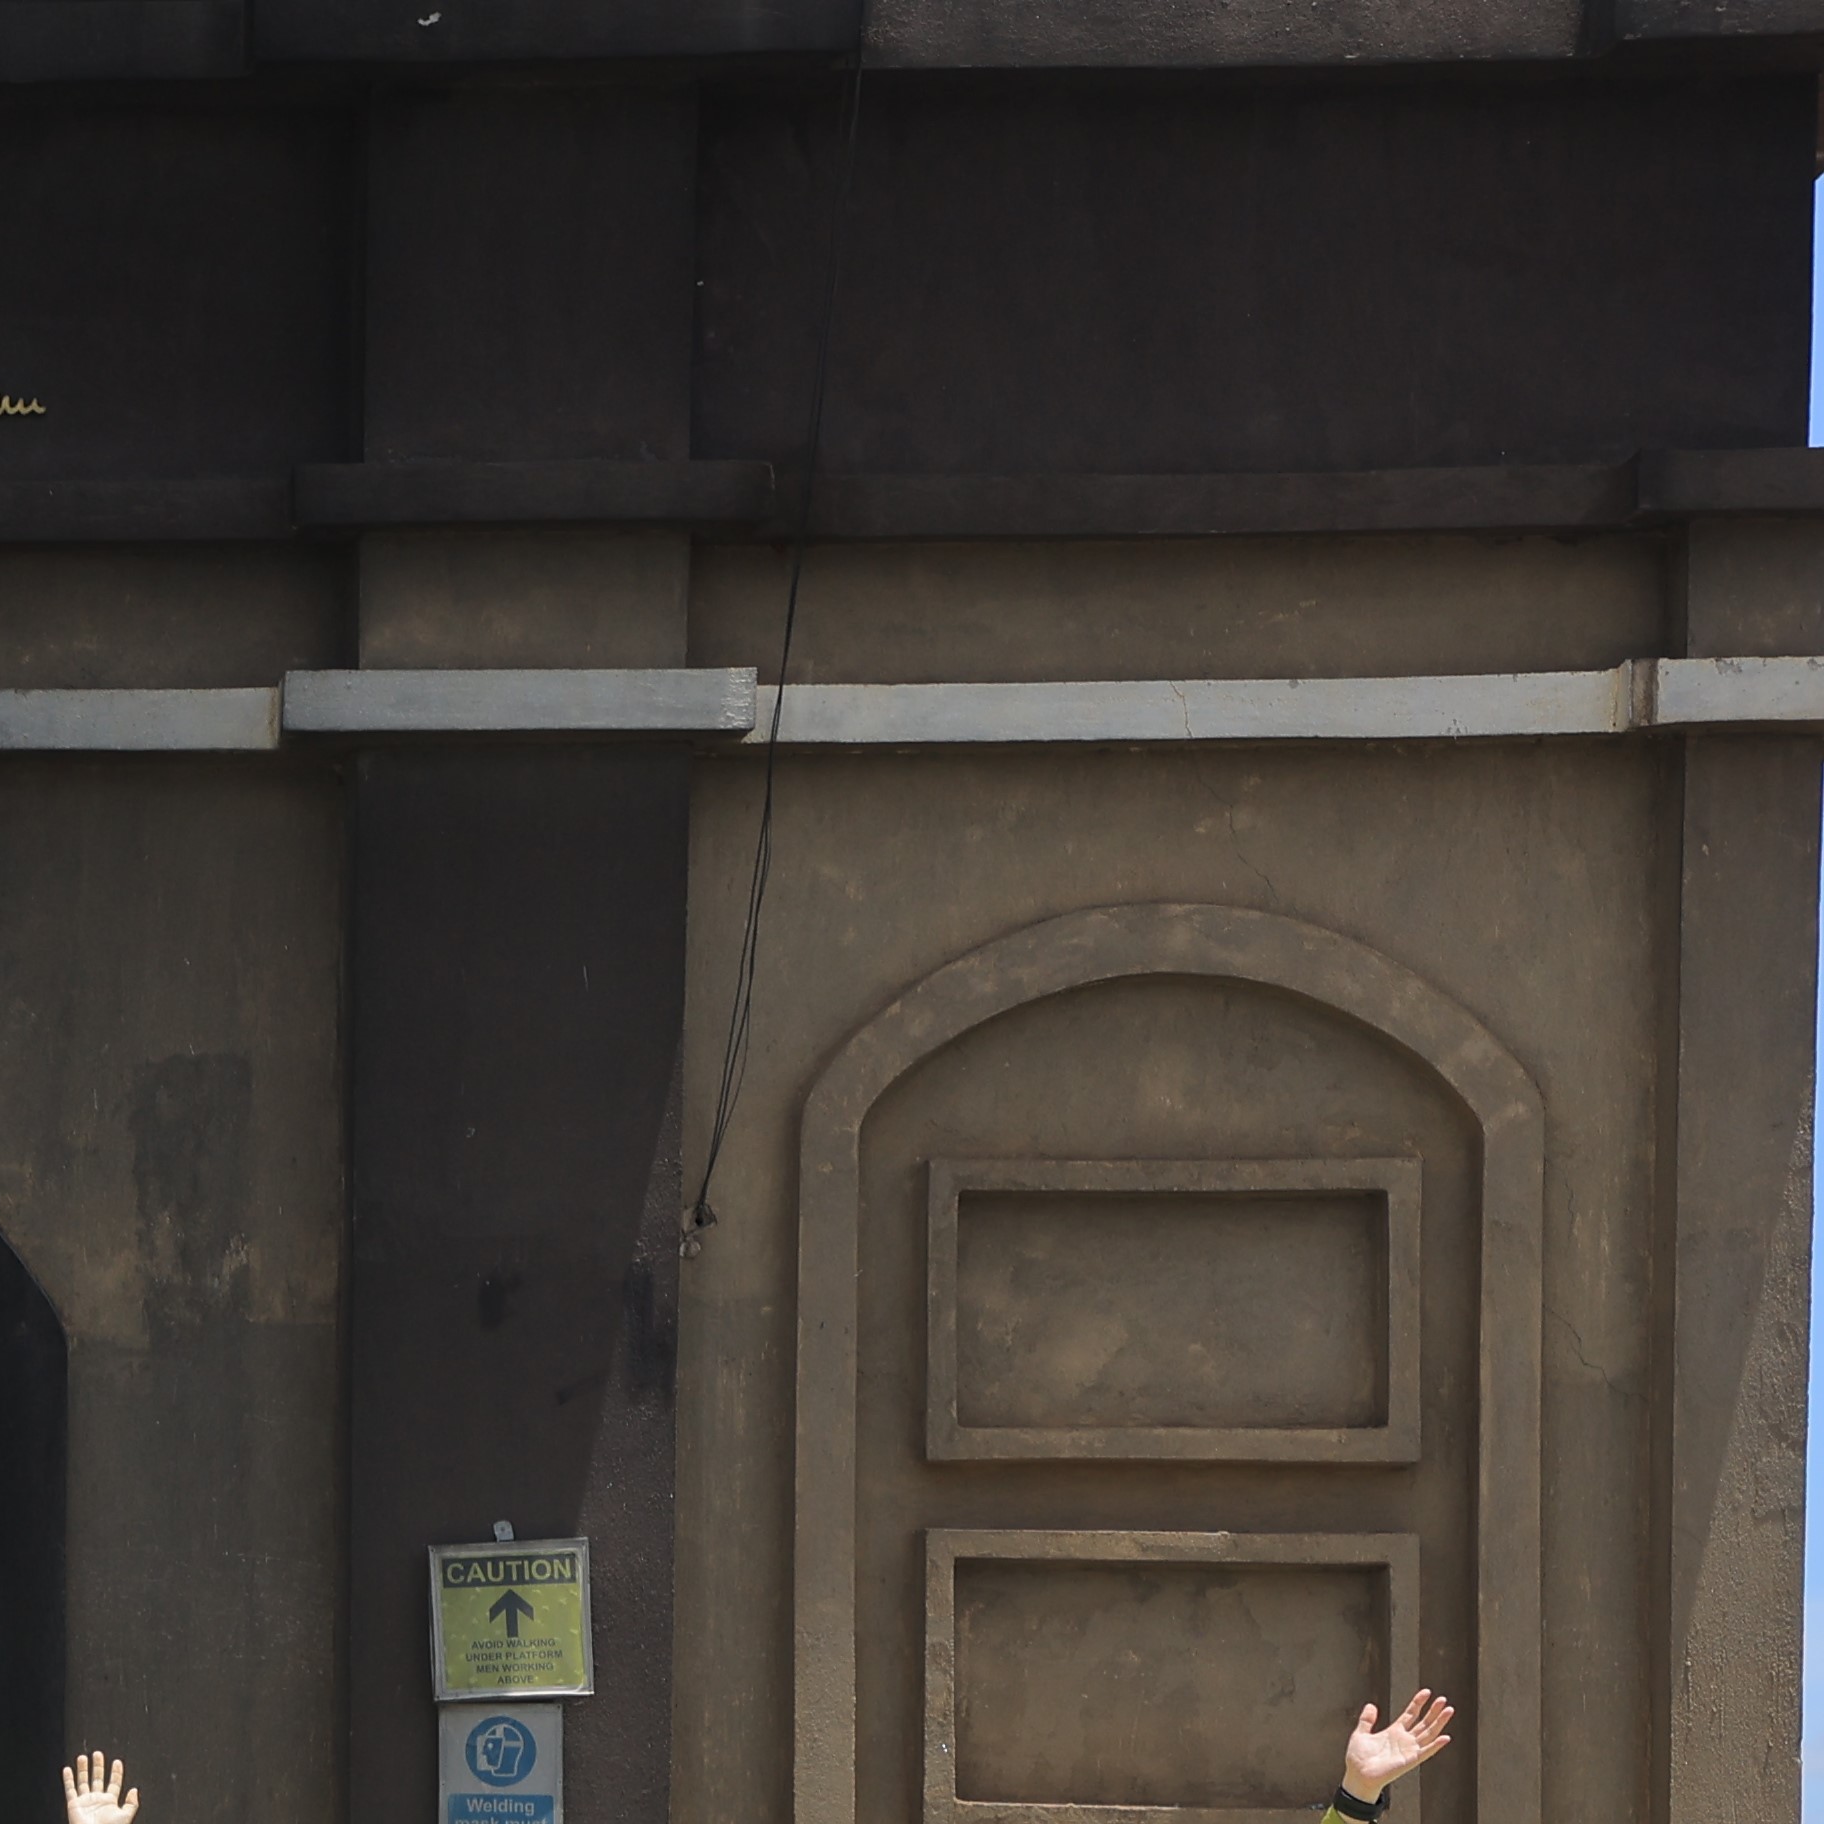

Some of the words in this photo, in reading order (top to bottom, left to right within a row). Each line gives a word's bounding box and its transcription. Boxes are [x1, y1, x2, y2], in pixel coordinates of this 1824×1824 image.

[446, 1557, 572, 1584] CAUTION
[471, 1640, 504, 1650] AVOID
[506, 1638, 556, 1648] WALKING
[465, 1652, 502, 1662] UNDER
[505, 1649, 563, 1660] PLATFORM
[476, 1664, 499, 1674] MEN
[502, 1662, 554, 1673] WORKING
[497, 1675, 534, 1684] ABOVE
[466, 1797, 535, 1816] Welding
